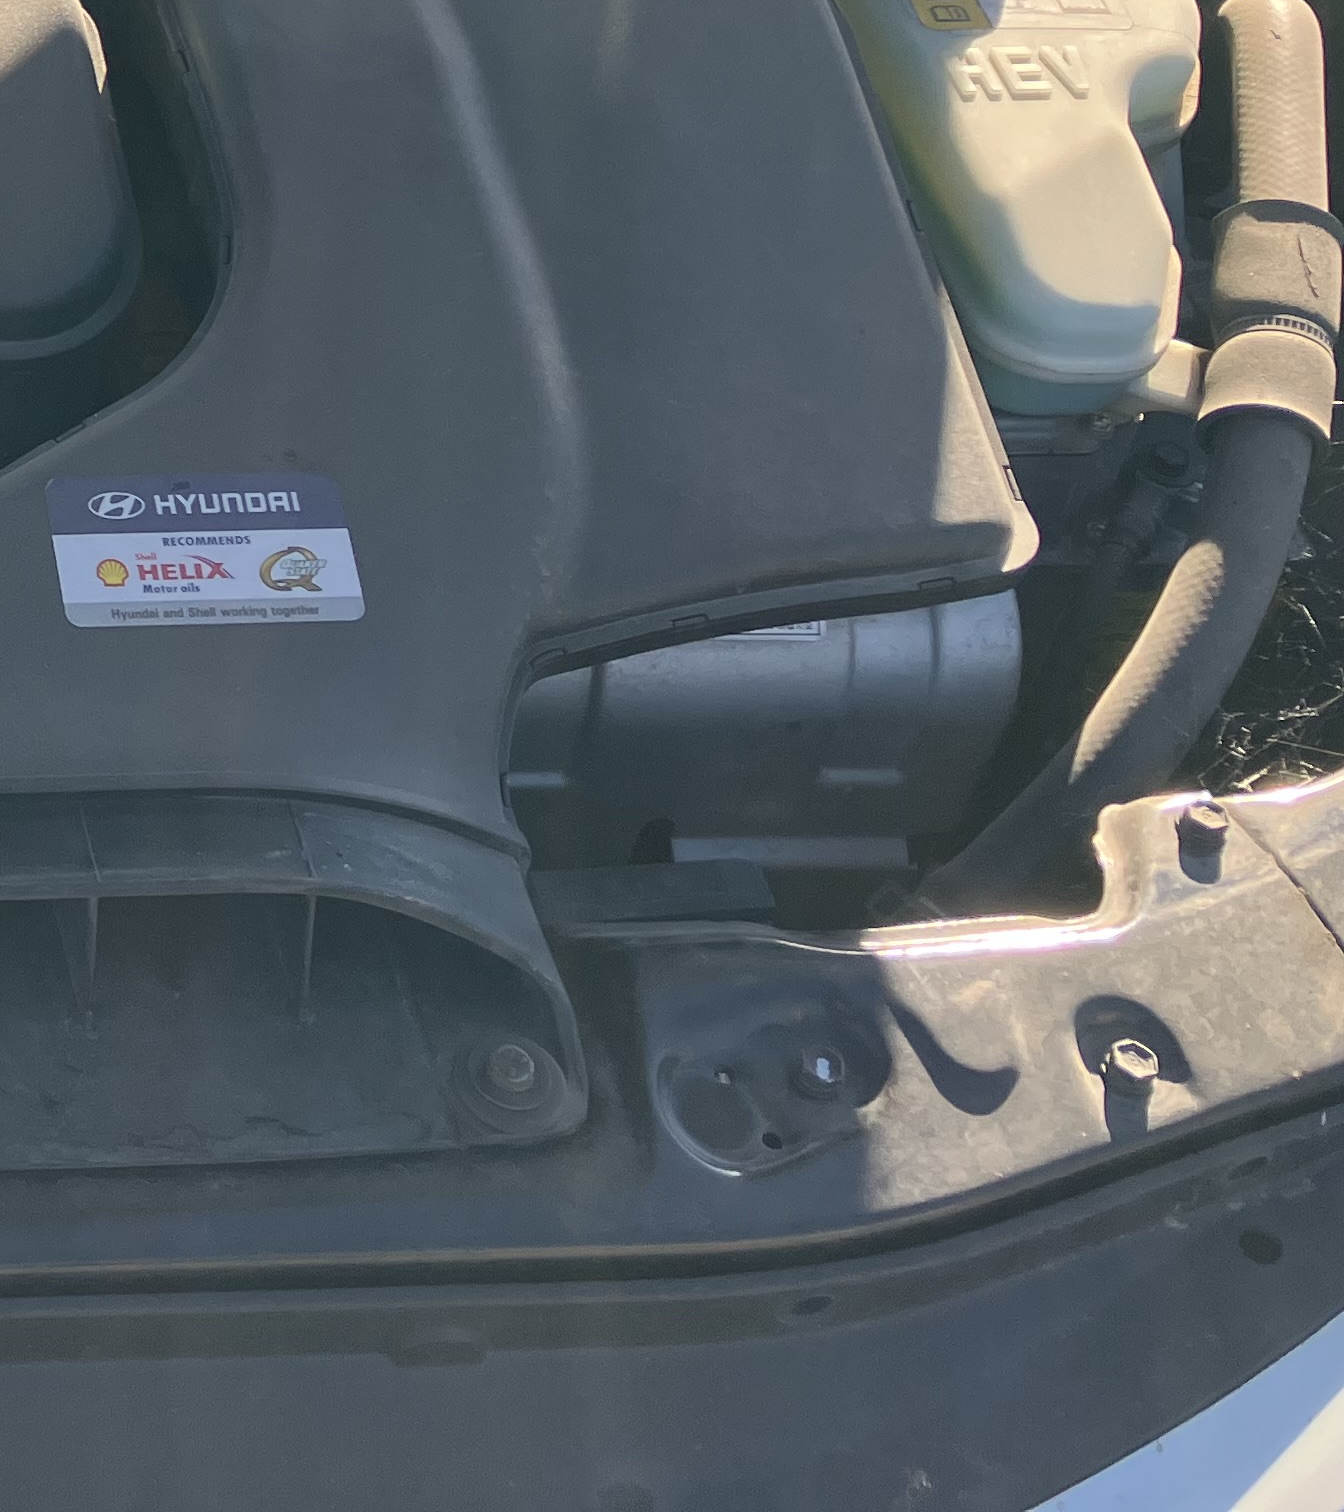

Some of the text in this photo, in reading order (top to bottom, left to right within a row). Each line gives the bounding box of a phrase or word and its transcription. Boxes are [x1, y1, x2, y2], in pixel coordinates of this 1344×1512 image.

[948, 44, 1090, 102] HEV
[153, 491, 301, 515] HYUNDAI
[163, 536, 251, 547] RECOMMENDS
[135, 553, 158, 562] Shell
[136, 559, 233, 580] HELIX
[142, 583, 201, 594] Motor oils
[111, 604, 321, 621] Hyundai and Shell working together
